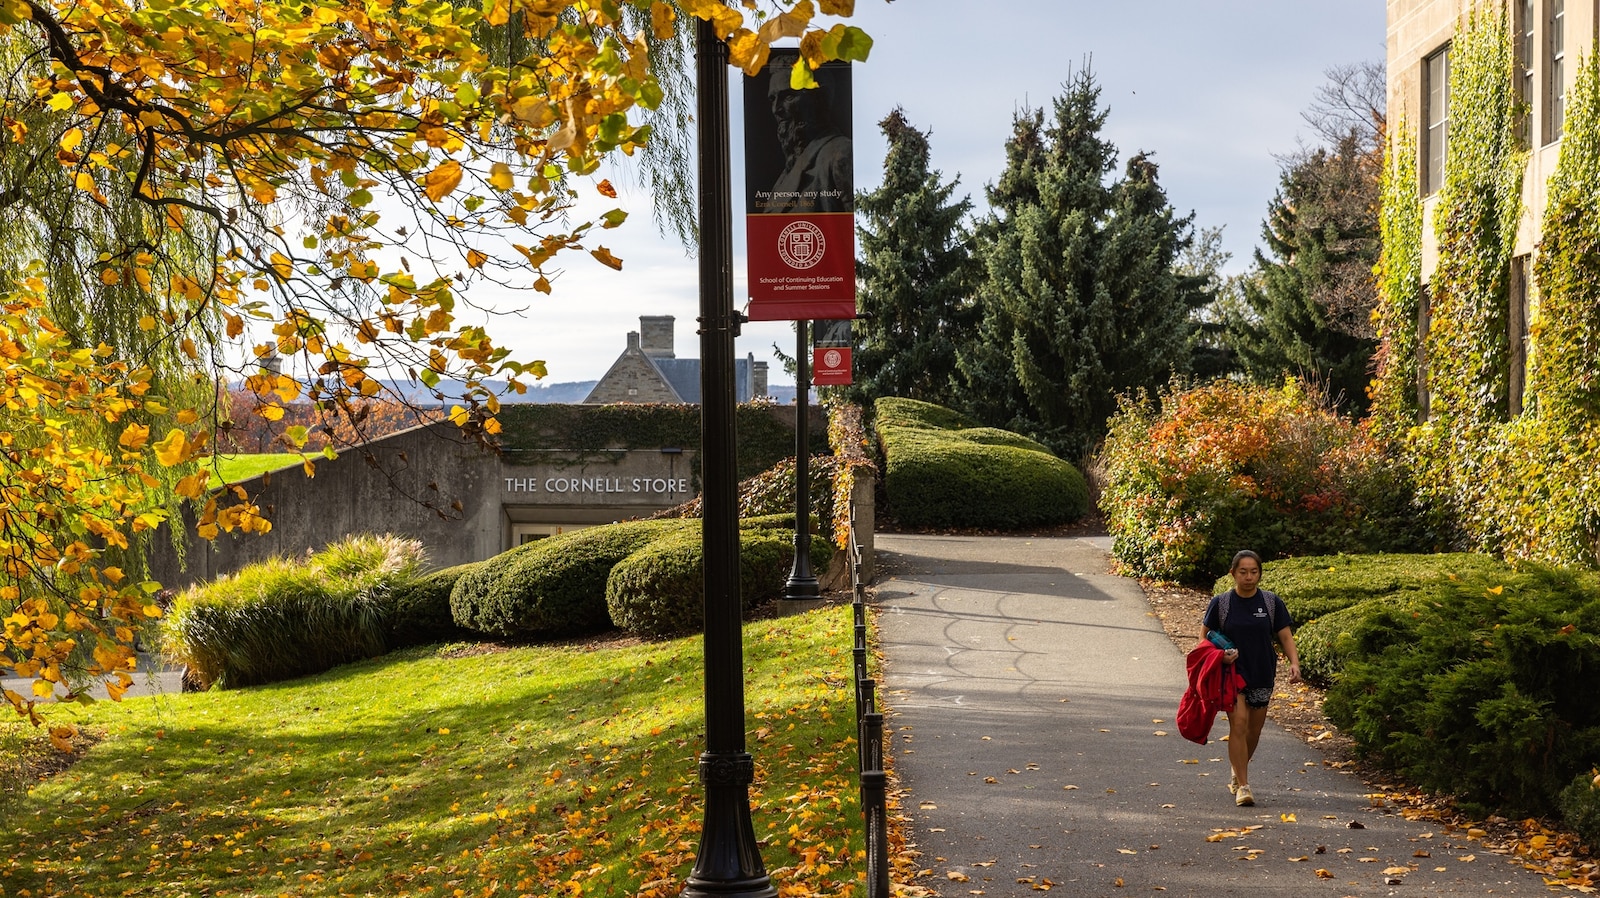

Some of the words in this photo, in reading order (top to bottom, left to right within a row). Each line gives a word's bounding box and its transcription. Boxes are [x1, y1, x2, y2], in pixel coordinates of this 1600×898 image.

[755, 190, 772, 200] Any
[773, 190, 802, 200] person,
[803, 190, 820, 199] any
[820, 188, 842, 199] study
[785, 276, 816, 284] Continuing
[505, 478, 537, 492] THE
[545, 478, 624, 492] CORNELL
[632, 478, 687, 492] STORE
